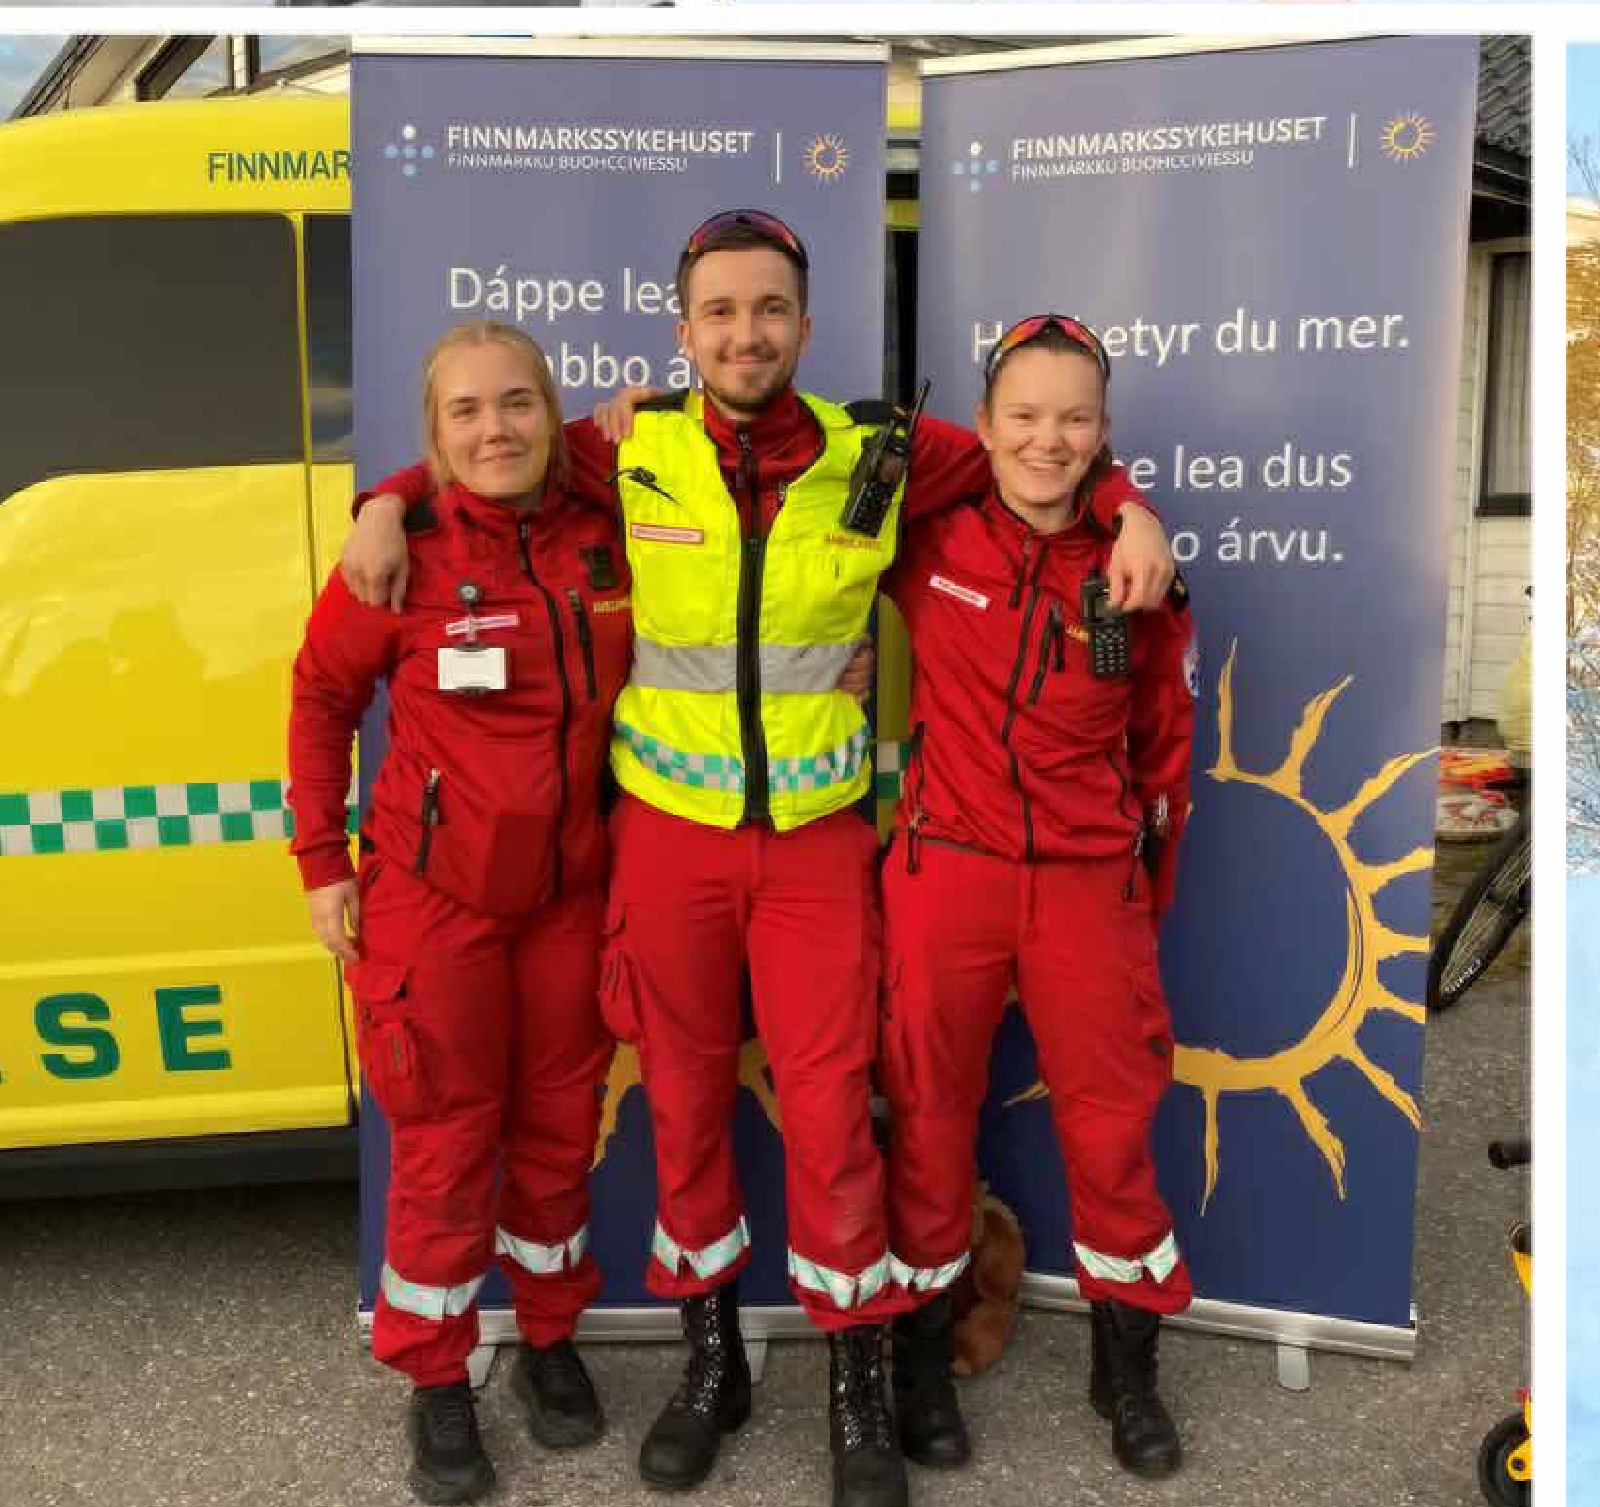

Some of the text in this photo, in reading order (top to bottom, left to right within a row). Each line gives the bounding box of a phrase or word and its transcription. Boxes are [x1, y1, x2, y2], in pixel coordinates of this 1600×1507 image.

[448, 125, 754, 155] FINNMARKSSYKEHUSET
[1012, 116, 1328, 160] FINNMARKSSYKEHUSET
[450, 264, 605, 322] Dáppe
[1090, 317, 1200, 367] etyr
[1216, 307, 1278, 354] du
[1298, 314, 1410, 350] mer.
[546, 341, 651, 389] bbo
[1173, 444, 1244, 489] lea
[1263, 441, 1354, 489] dus
[1217, 516, 1345, 562] árvu.
